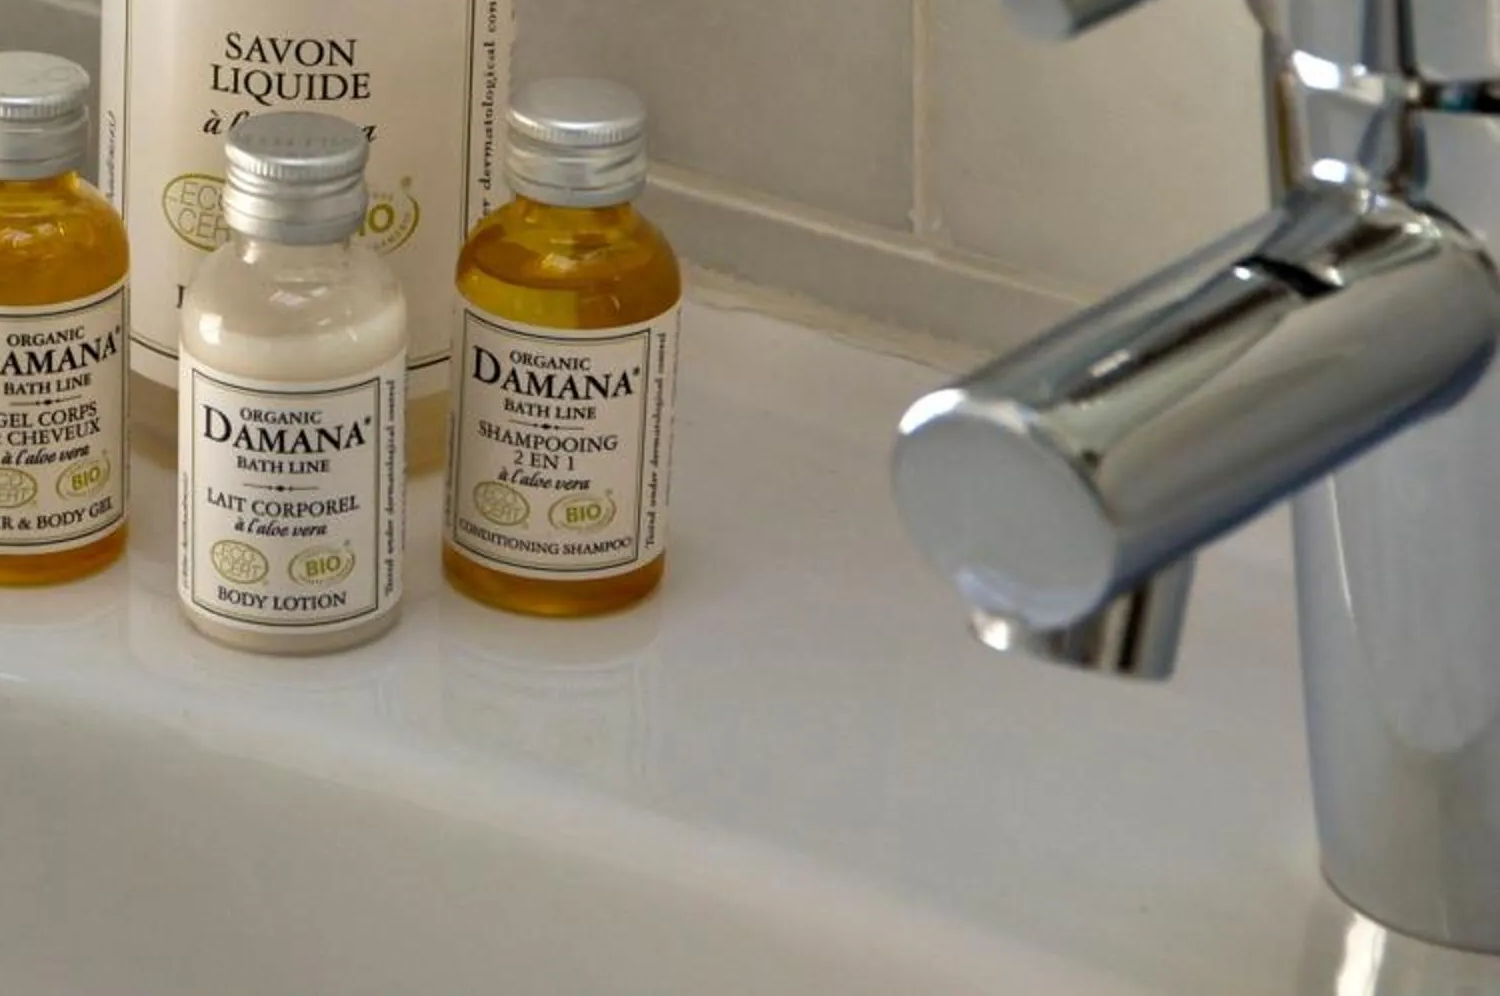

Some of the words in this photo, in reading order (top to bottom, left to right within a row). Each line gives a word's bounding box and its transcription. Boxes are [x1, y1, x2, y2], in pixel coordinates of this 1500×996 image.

[224, 31, 358, 68] SAVON
[209, 64, 372, 106] LIQUIDE
[203, 109, 223, 135] à
[477, 41, 497, 191] dermatological
[6, 325, 85, 348] ORGANIC
[509, 350, 591, 371] ORGANIC
[3, 381, 51, 396] BATH
[56, 373, 92, 392] LINE
[39, 401, 98, 427] CORPS
[240, 406, 323, 425] ORGANIC
[503, 398, 550, 420] BATH
[555, 404, 597, 421] LINE
[7, 418, 101, 446] CHEVEUX
[477, 420, 618, 453] SHAMPOOING
[59, 445, 90, 462] vera
[236, 456, 283, 474] BATH
[288, 458, 330, 474] LINE
[513, 451, 524, 466] 2
[529, 455, 560, 471] EN
[567, 456, 575, 471] 1
[70, 465, 101, 491] BIO
[554, 478, 590, 491] vera
[207, 487, 247, 513] LAIT
[251, 495, 360, 519] CORPOREL
[565, 503, 602, 524] BIO
[18, 517, 32, 530] &
[36, 509, 85, 531] BODY
[292, 524, 327, 537] vera
[459, 517, 559, 554] CONDITIONING
[562, 536, 632, 555] SHAMPOO
[304, 555, 341, 578] BIO
[217, 585, 268, 610] BODY
[273, 591, 348, 611] LOTION
